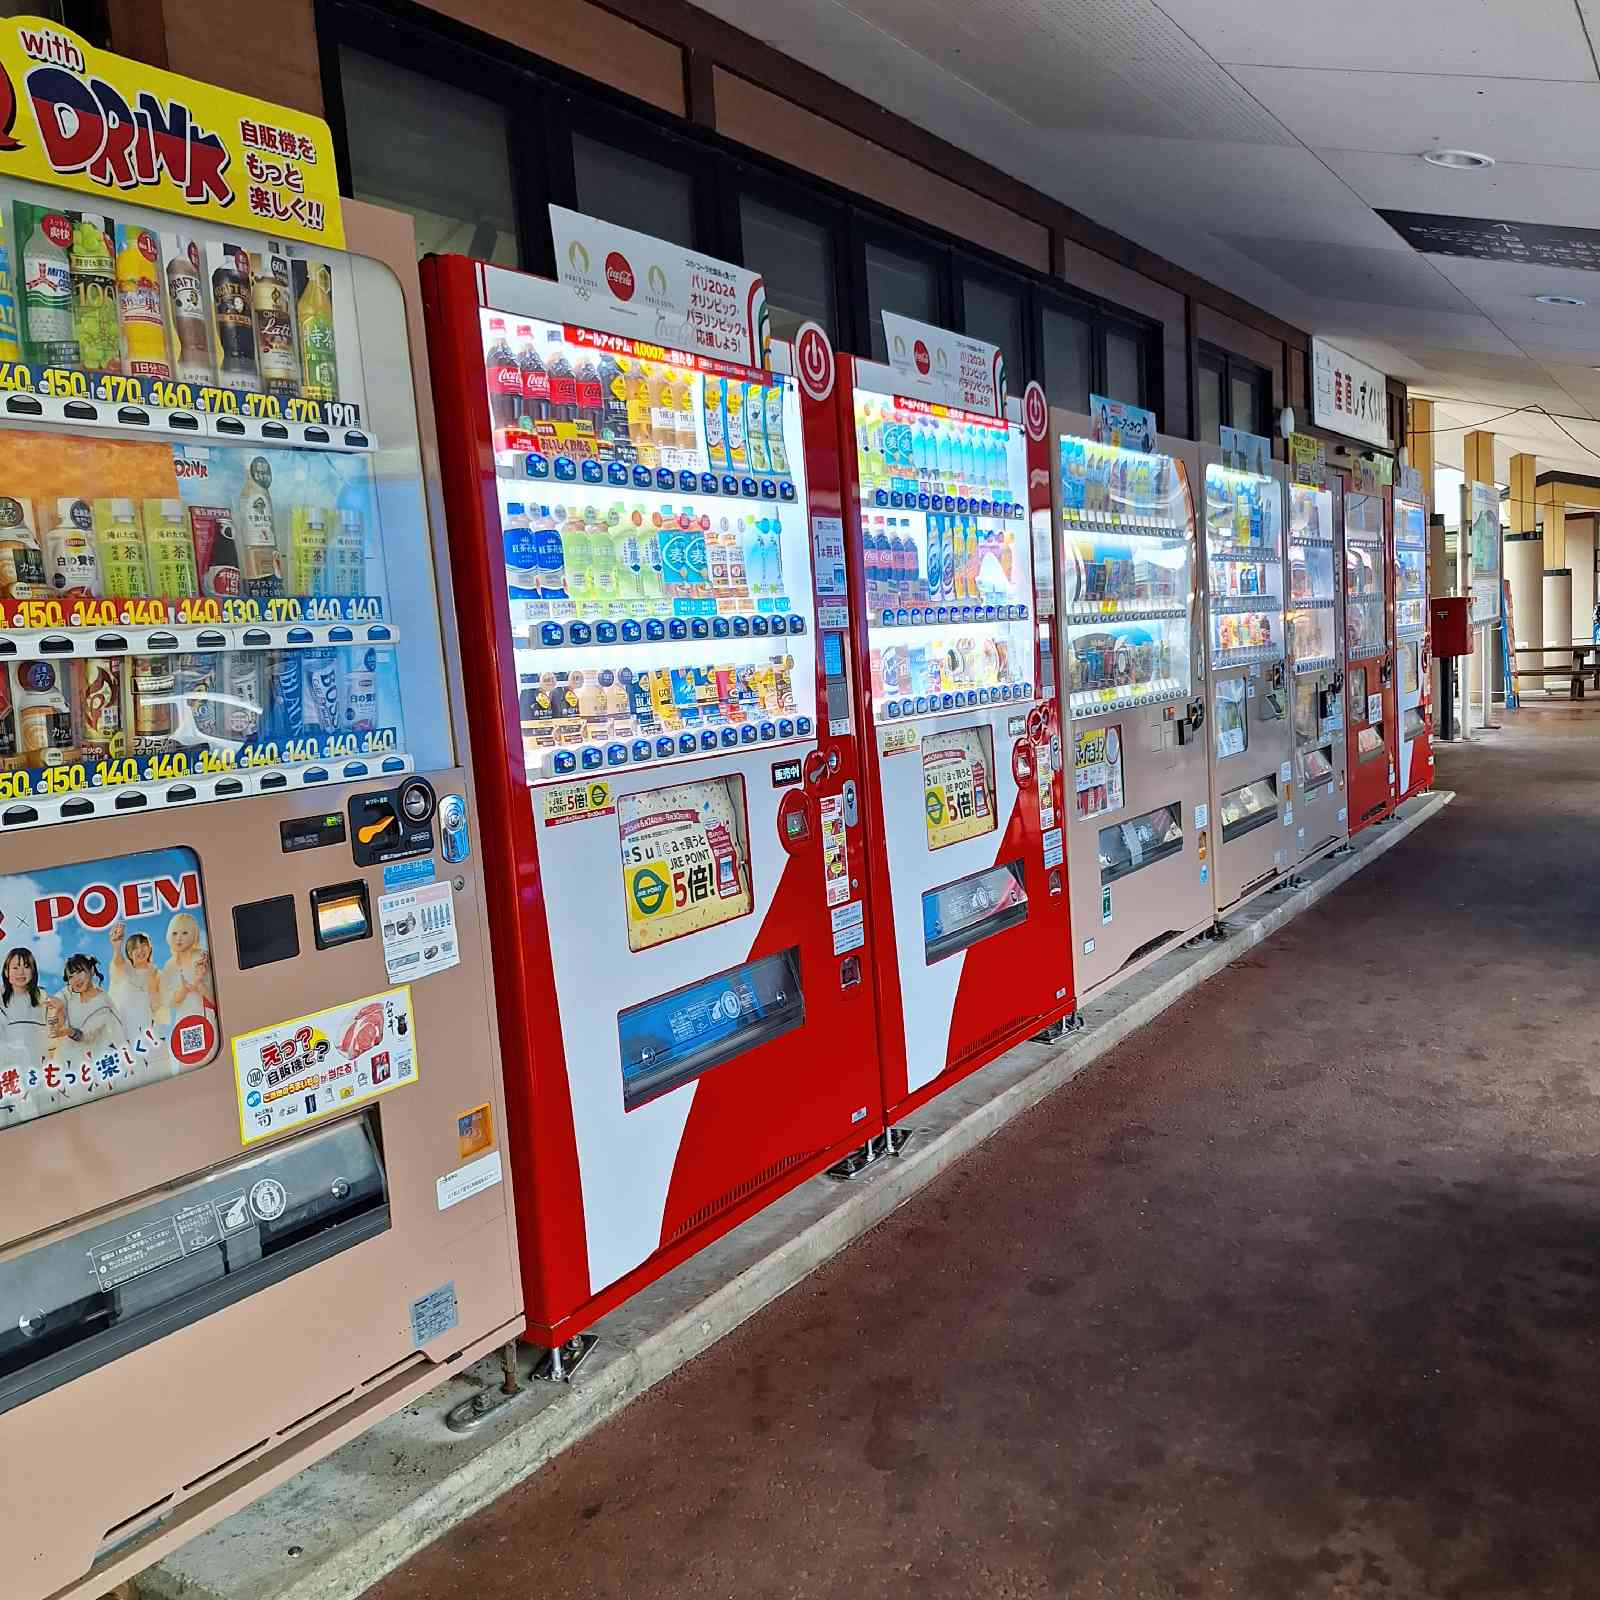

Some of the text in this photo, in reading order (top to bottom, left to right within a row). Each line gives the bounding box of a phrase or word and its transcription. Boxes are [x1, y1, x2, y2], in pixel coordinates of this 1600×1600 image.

[21, 29, 84, 71] with
[239, 119, 316, 163] 自販機を
[246, 153, 305, 193] もっと
[690, 273, 736, 299] パリ2024
[43, 368, 86, 399] 150
[101, 375, 141, 405] 170
[154, 382, 192, 409] 160
[201, 388, 236, 416] 170
[247, 393, 279, 421] 170
[288, 397, 320, 424] 170
[325, 402, 355, 427] 190
[18, 599, 380, 625] 150 140 140 140 130 170 140 140
[42, 764, 85, 793] 150
[97, 758, 138, 786] 140
[148, 752, 187, 779] 140
[200, 748, 235, 774] 140
[246, 743, 279, 768] 140
[286, 738, 318, 761] 140
[327, 734, 357, 756] 140
[365, 729, 394, 751] 140
[670, 848, 712, 870] JRE POINT
[34, 873, 200, 933] POEM
[673, 862, 716, 908] 5倍!
